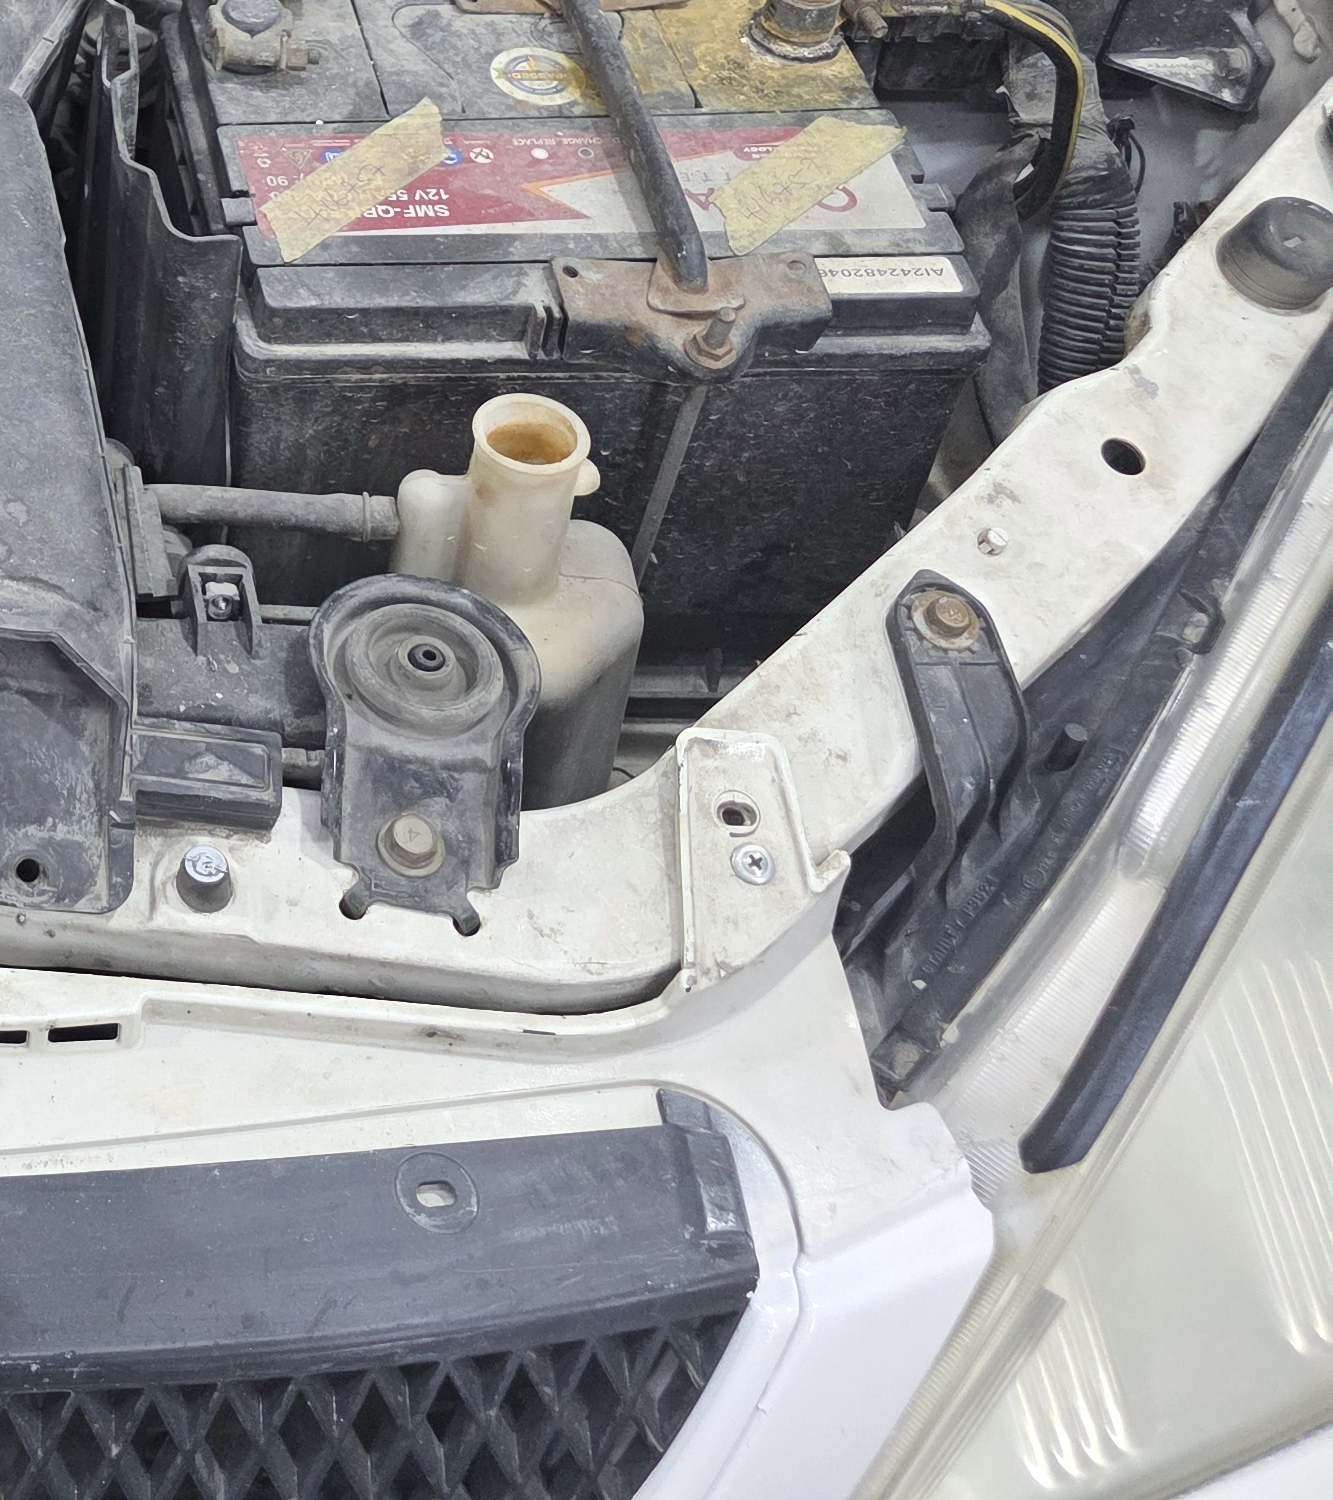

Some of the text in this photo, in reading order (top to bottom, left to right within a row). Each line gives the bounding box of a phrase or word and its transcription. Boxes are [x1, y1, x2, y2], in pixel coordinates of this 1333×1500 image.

[511, 138, 556, 146] REPLACE
[562, 137, 602, 145] CHARGE
[266, 176, 290, 186] 90
[414, 188, 450, 201] 12V
